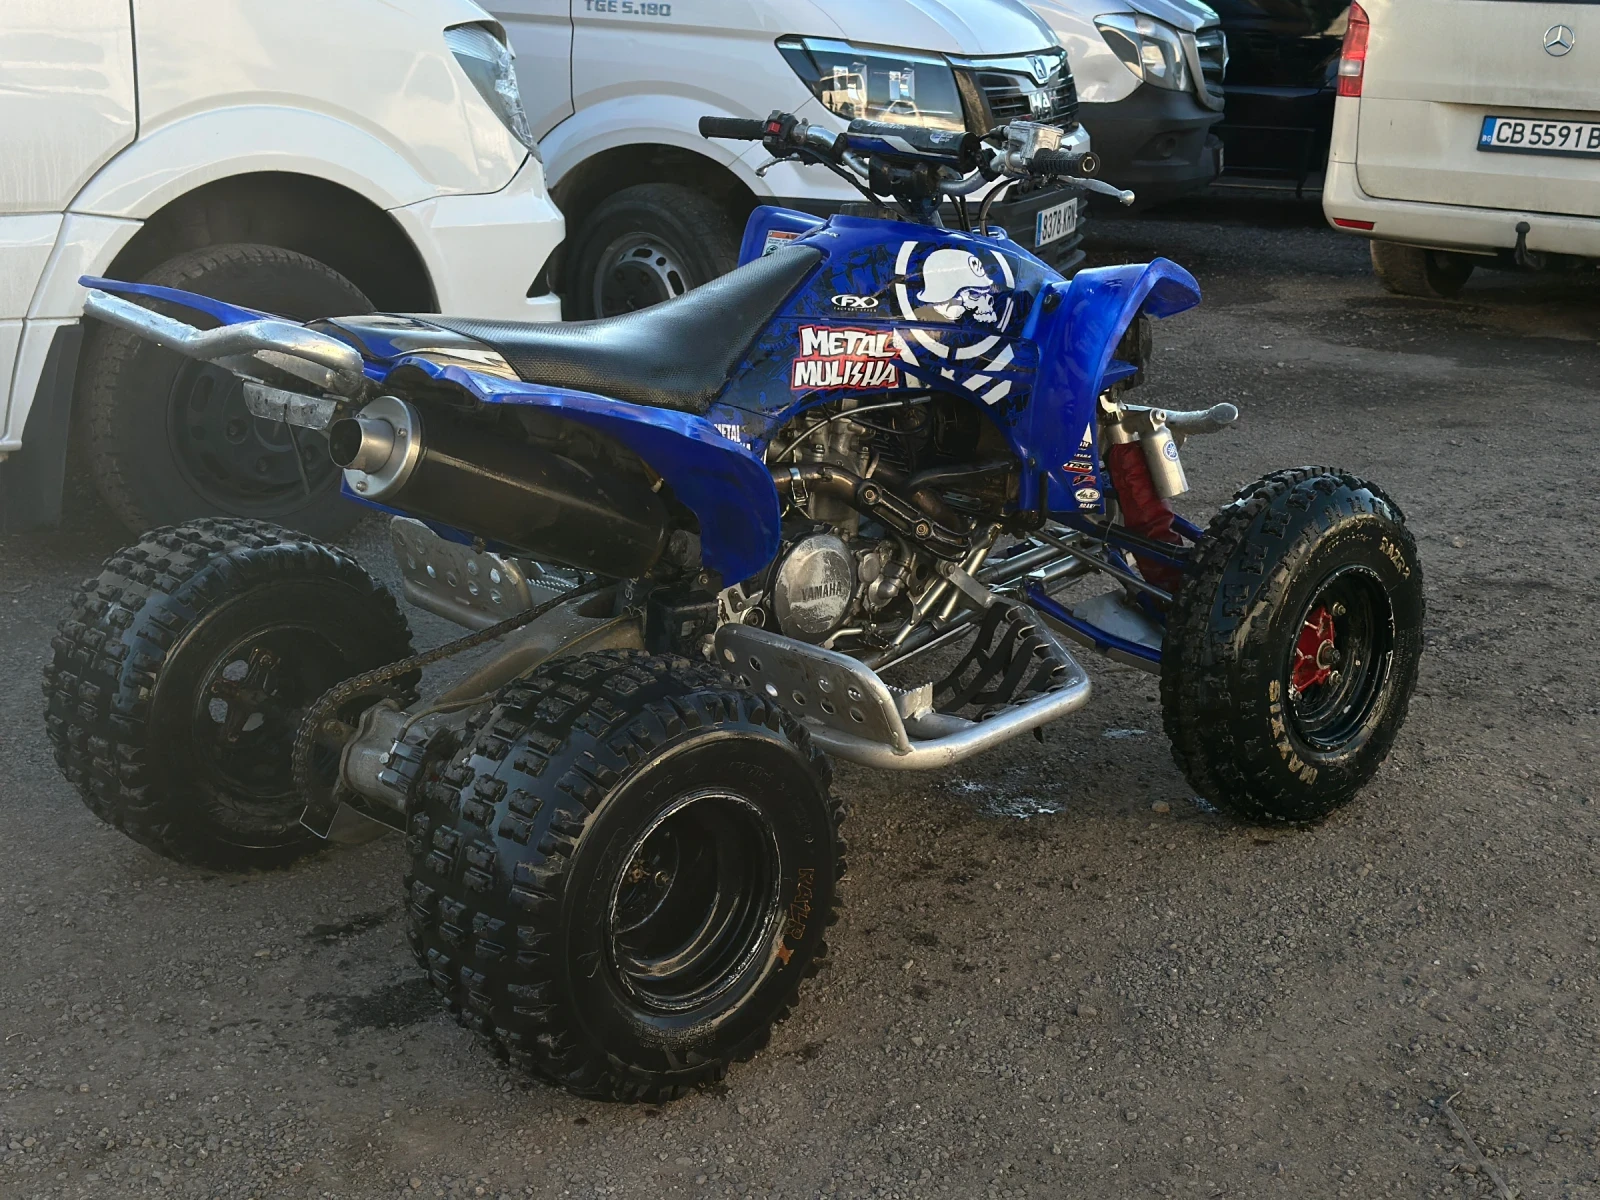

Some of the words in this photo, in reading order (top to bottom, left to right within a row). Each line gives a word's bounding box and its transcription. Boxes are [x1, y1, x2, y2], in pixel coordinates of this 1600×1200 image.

[584, 0, 617, 13] TGE
[621, 1, 671, 16] 5.180
[801, 327, 896, 358] METAL
[794, 360, 896, 387] MULISHA
[802, 582, 842, 601] YAMAHA
[1268, 679, 1318, 786] MAXXIS
